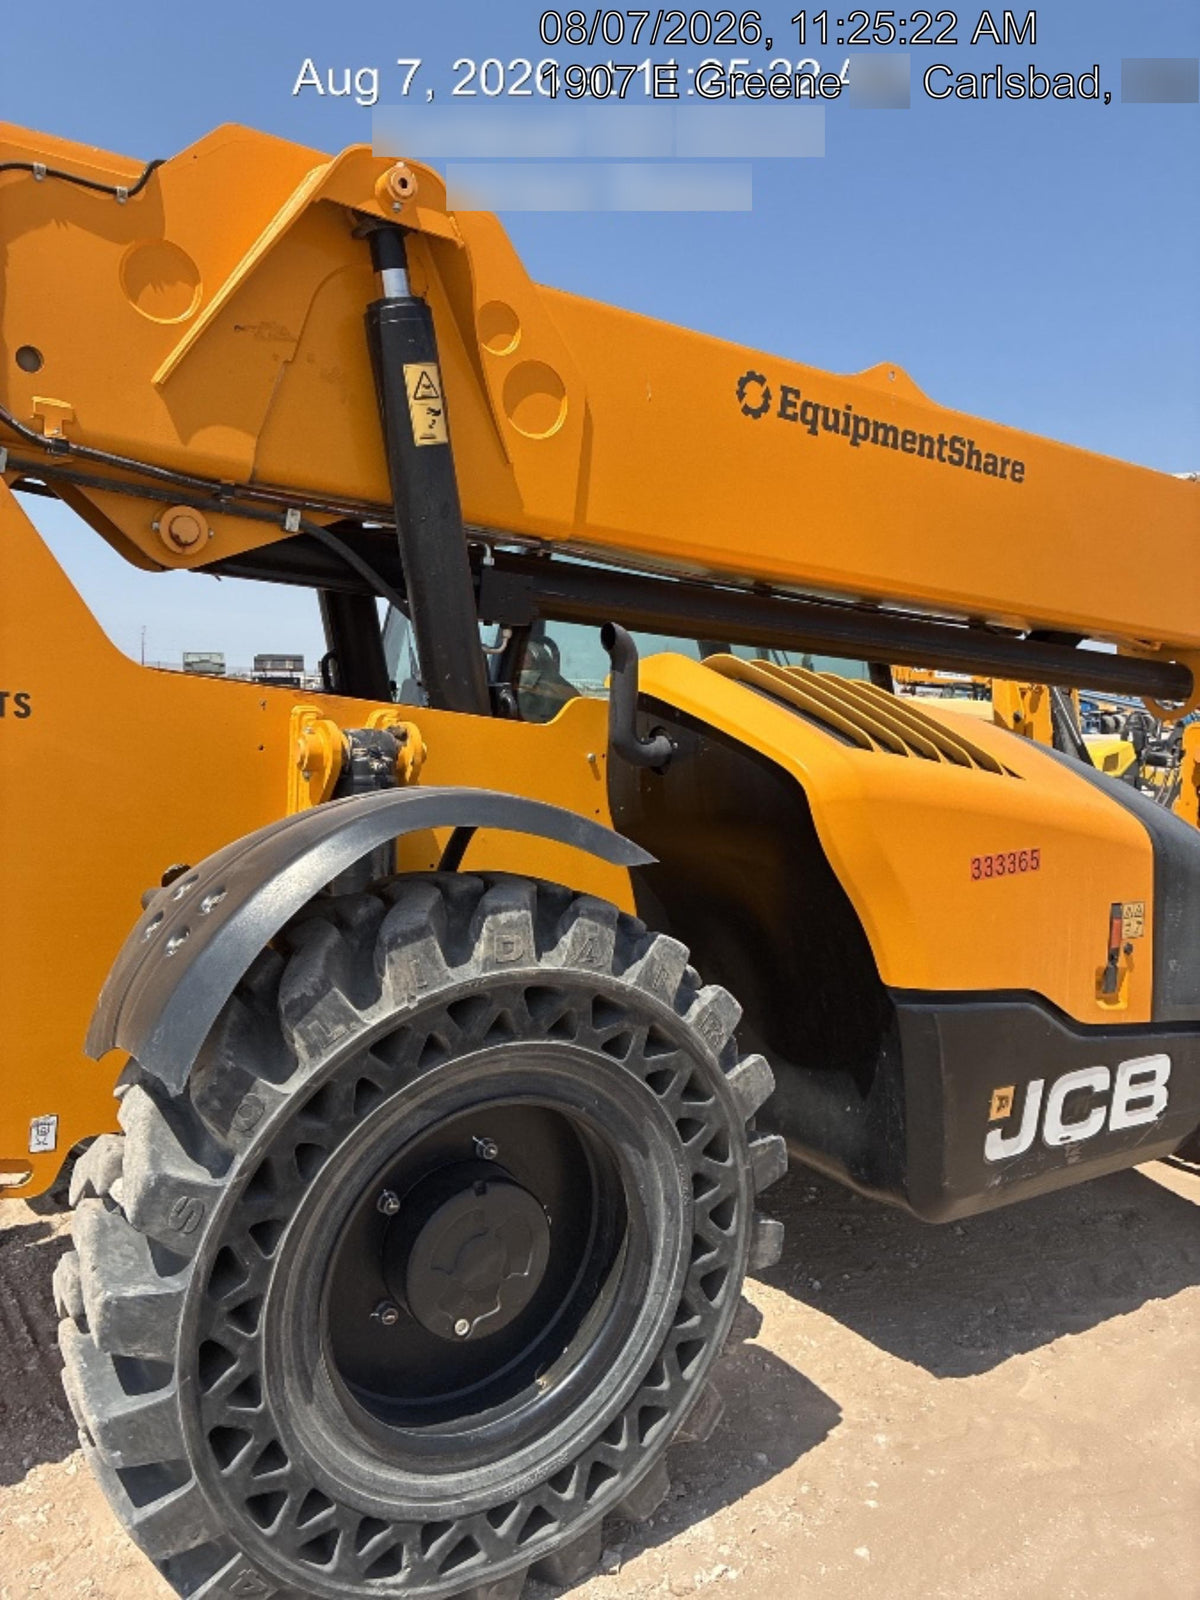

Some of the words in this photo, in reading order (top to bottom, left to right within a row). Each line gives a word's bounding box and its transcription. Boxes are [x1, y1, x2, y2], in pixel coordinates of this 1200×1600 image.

[776, 384, 1026, 484] EquipmentShare
[970, 849, 1040, 881] 333365
[983, 1053, 1171, 1162] JCB
